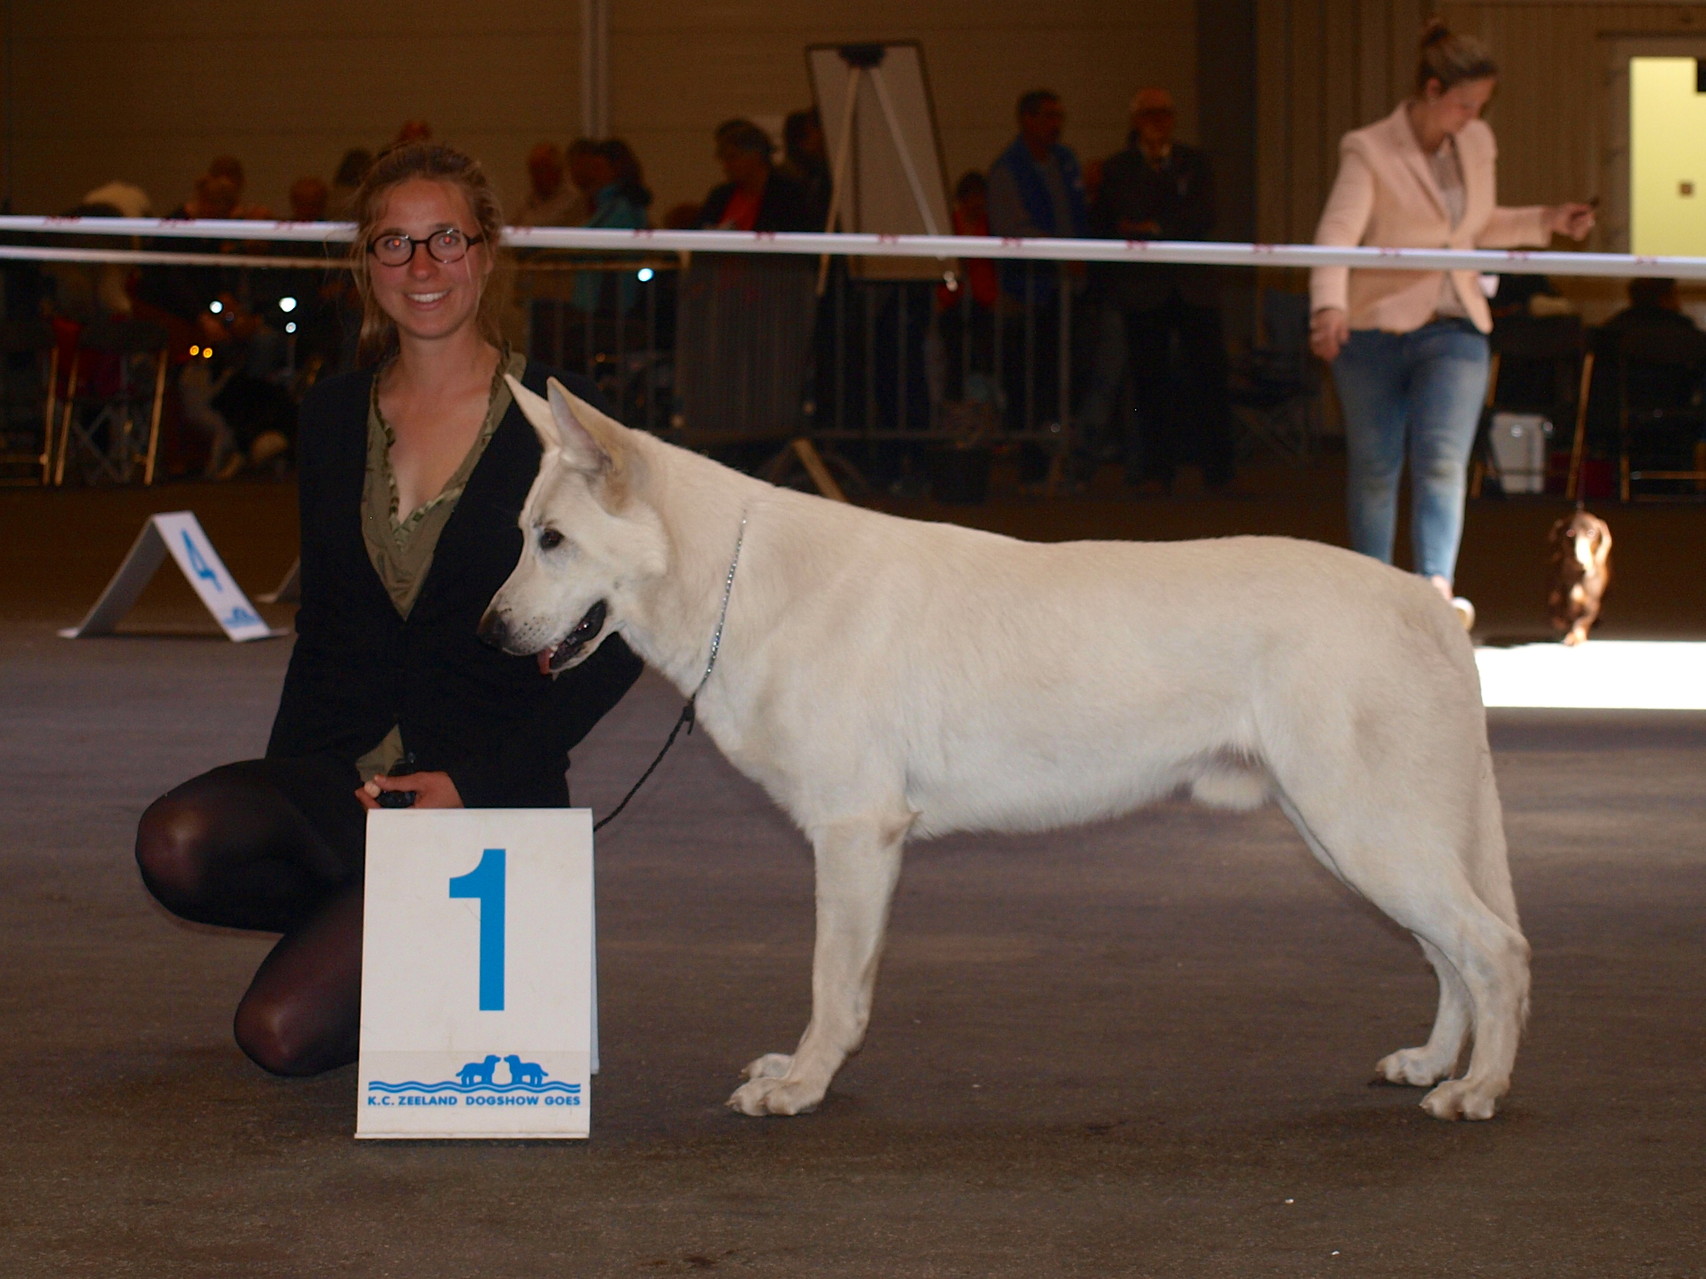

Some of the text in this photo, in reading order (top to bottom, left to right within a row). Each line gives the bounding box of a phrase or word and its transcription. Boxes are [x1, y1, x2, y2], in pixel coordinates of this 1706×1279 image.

[180, 528, 222, 592] 4
[449, 849, 505, 1011] 1
[367, 1095, 581, 1106] K.C. ZEELAND DOGSHOW GOES
